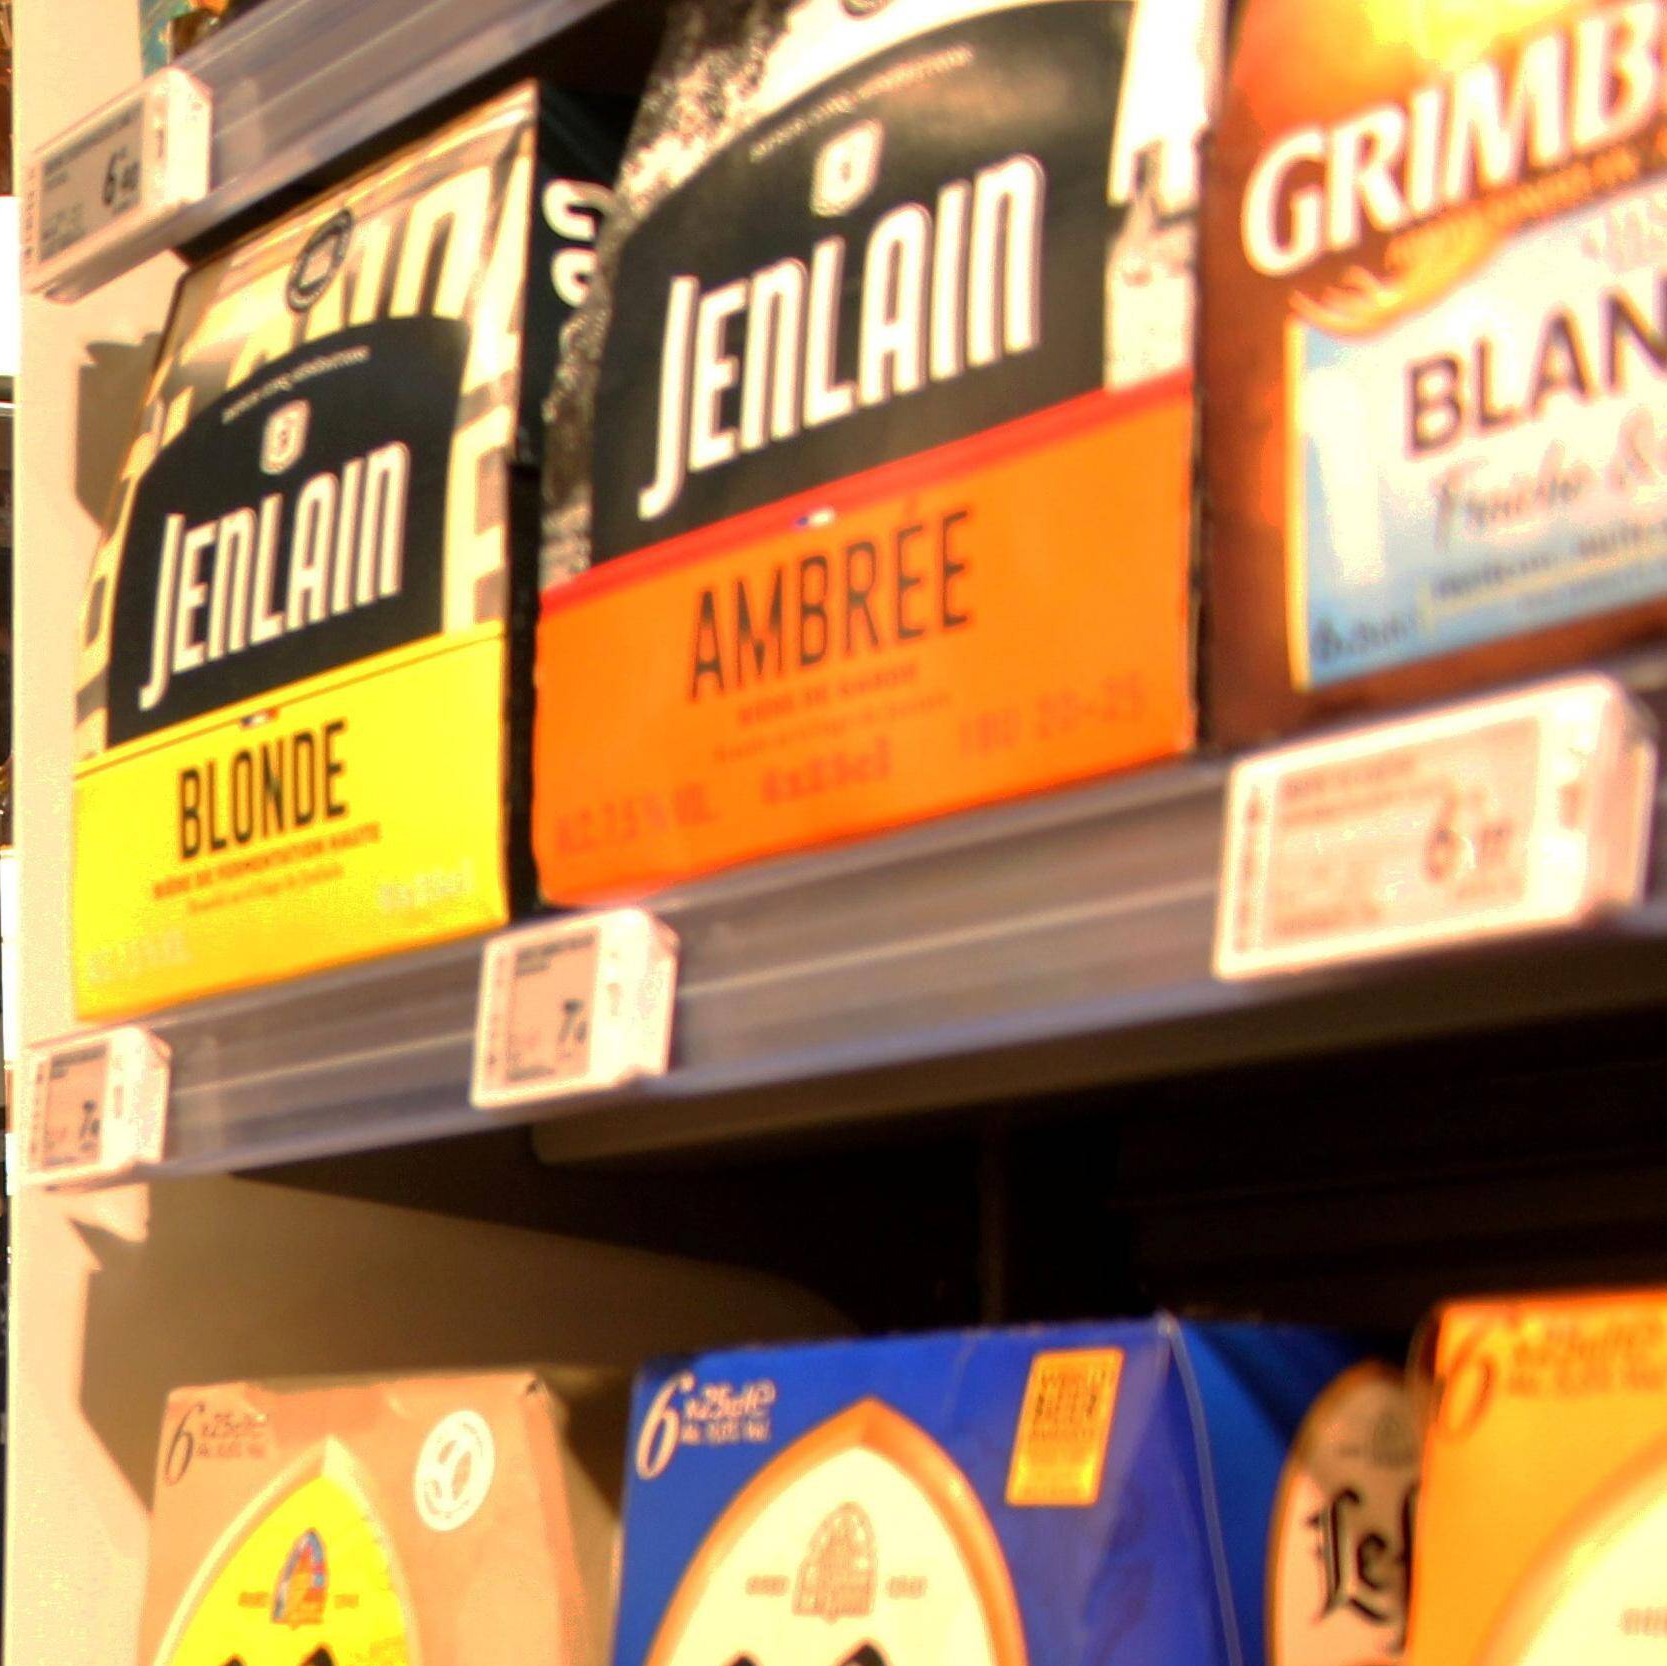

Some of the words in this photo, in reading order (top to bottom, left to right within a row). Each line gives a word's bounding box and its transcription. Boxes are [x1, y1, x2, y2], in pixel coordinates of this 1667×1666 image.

[638, 152, 1048, 522] JENLAIN
[140, 440, 410, 703] JENLAIN
[691, 496, 973, 702] AMBRÉE
[178, 717, 351, 862] BLONDE
[165, 1403, 206, 1487] 6
[635, 1368, 697, 1480] 6
